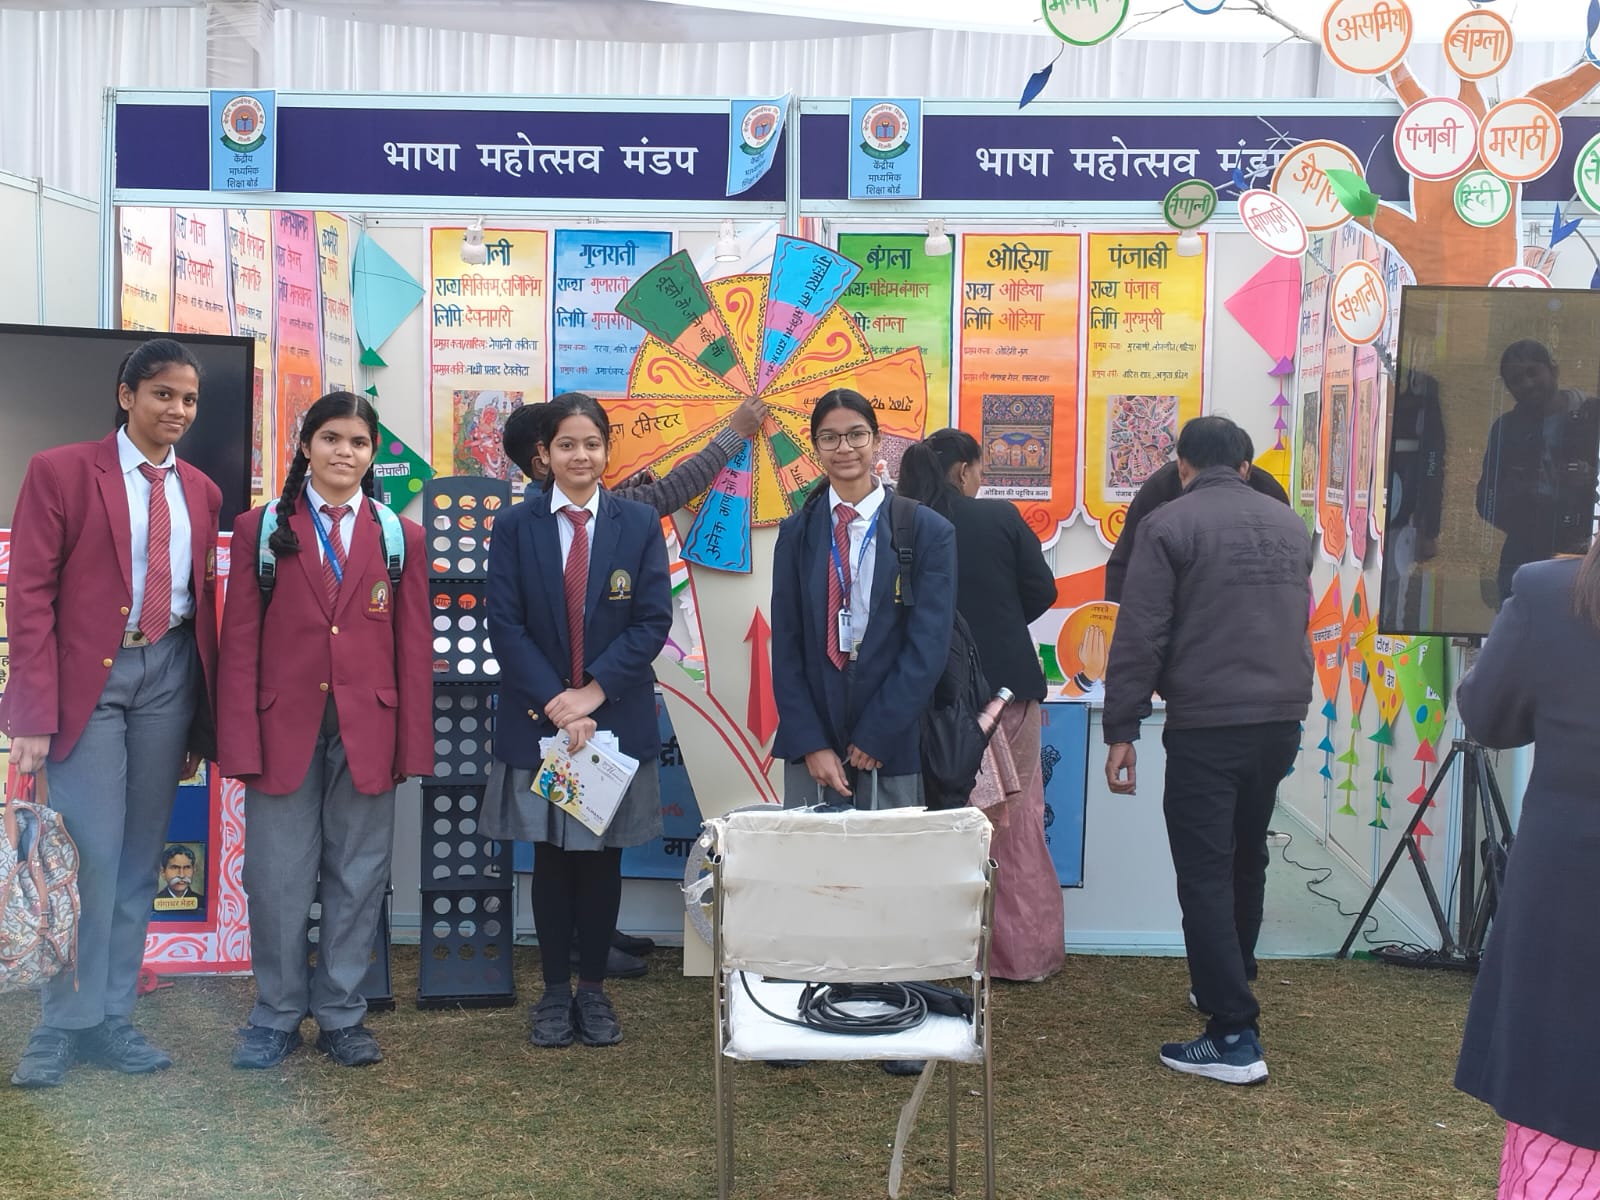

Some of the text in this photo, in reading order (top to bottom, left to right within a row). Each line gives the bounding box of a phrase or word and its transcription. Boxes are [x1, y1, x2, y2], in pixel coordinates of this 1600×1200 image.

[1336, 1, 1407, 42] असमिया
[1450, 24, 1505, 62] बांग्ला
[1405, 117, 1463, 154] पंजाबी
[1489, 115, 1550, 161] मराठी
[383, 131, 699, 178] भाषा महोत्सव मंडप
[976, 147, 1054, 177] भाषा
[1070, 136, 1201, 181] महोत्सव
[227, 177, 259, 188] शिक्षा बोर्ड
[228, 165, 260, 176] माध्यमिक
[868, 172, 902, 183] माध्यमिक
[866, 184, 901, 195] शिक्षा बोर्ड
[1459, 180, 1501, 213] हिंदी
[1169, 193, 1211, 219] नेपाली
[579, 239, 640, 268] गुजराती
[866, 243, 912, 270] बंगला
[986, 243, 1053, 273] ओड़िया
[1108, 242, 1172, 270] पंजाबी
[557, 277, 586, 292] राज्य
[899, 280, 931, 298] बंगाल
[965, 283, 995, 301] राज्य
[1091, 278, 1163, 300] राज्य पंजाब
[799, 292, 812, 307] का
[556, 307, 588, 328] लिपि
[872, 314, 908, 333] बांग्ला
[964, 306, 1046, 331] लिपि ओड़िया
[1090, 306, 1120, 330] लिपि
[489, 337, 512, 350] नेपाली
[515, 337, 539, 351] कविता
[889, 396, 913, 411] शब्द
[704, 522, 725, 560] अनेक
[726, 468, 737, 478] में
